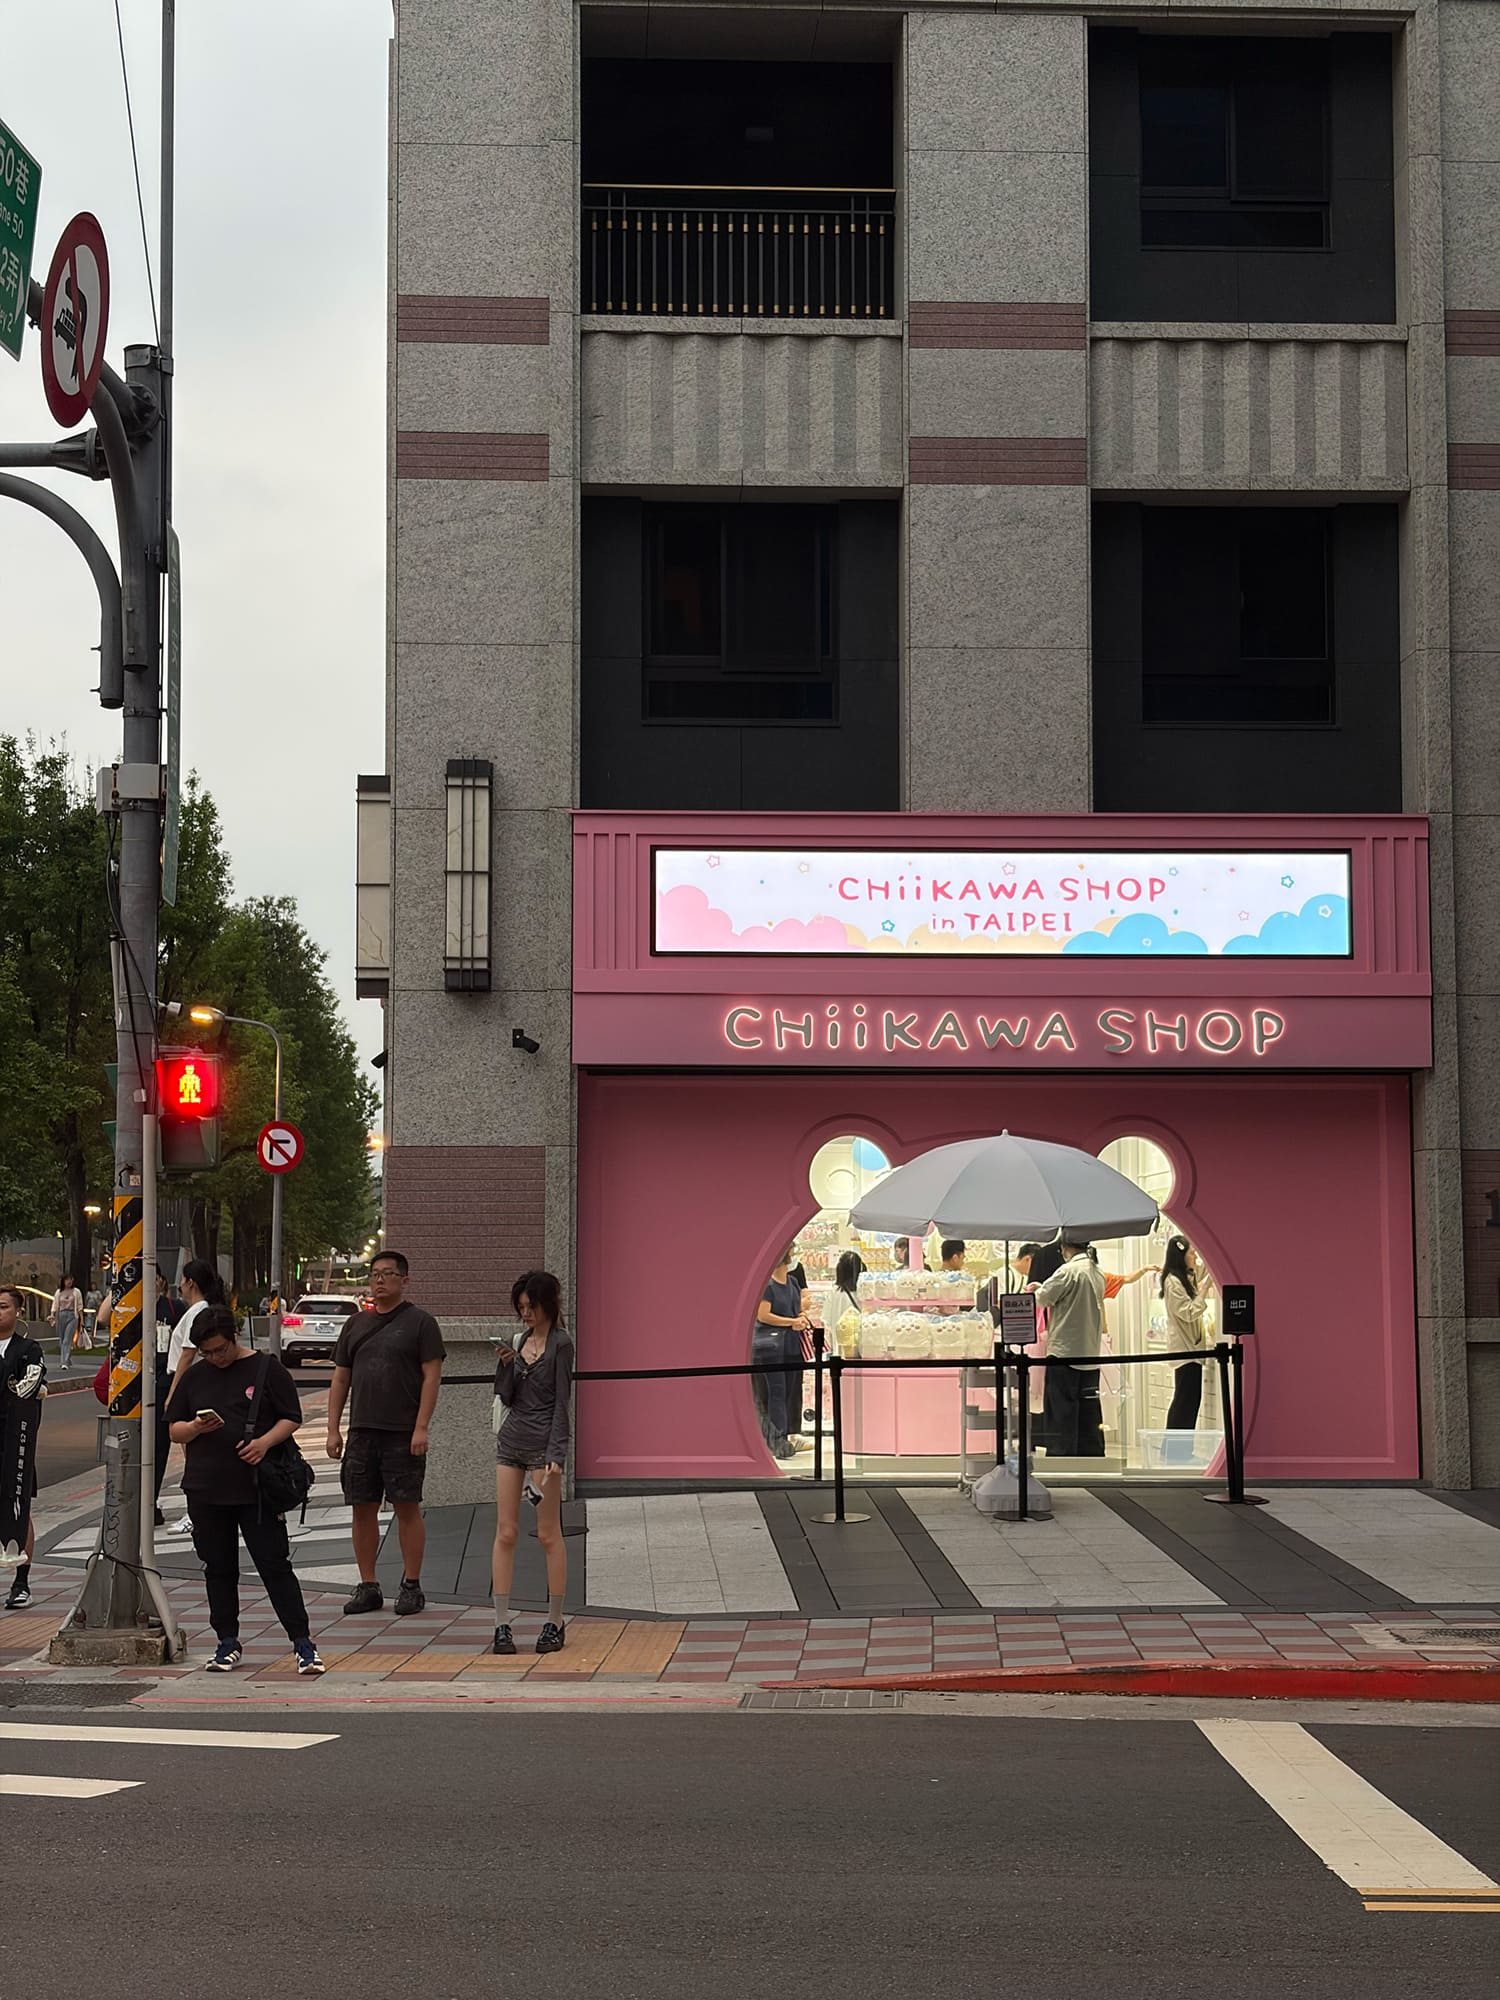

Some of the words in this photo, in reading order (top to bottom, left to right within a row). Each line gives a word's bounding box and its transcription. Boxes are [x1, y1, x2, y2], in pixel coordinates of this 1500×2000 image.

[12, 212, 24, 239] 50
[838, 875, 1045, 901] CHiiKAWA
[1058, 877, 1167, 902] SHOP
[931, 913, 955, 931] in
[964, 912, 1073, 932] TAIPEI
[724, 1003, 1077, 1052] CHiiKAWA
[1097, 1007, 1285, 1056] SHOP
[1229, 1299, 1247, 1309] 出口
